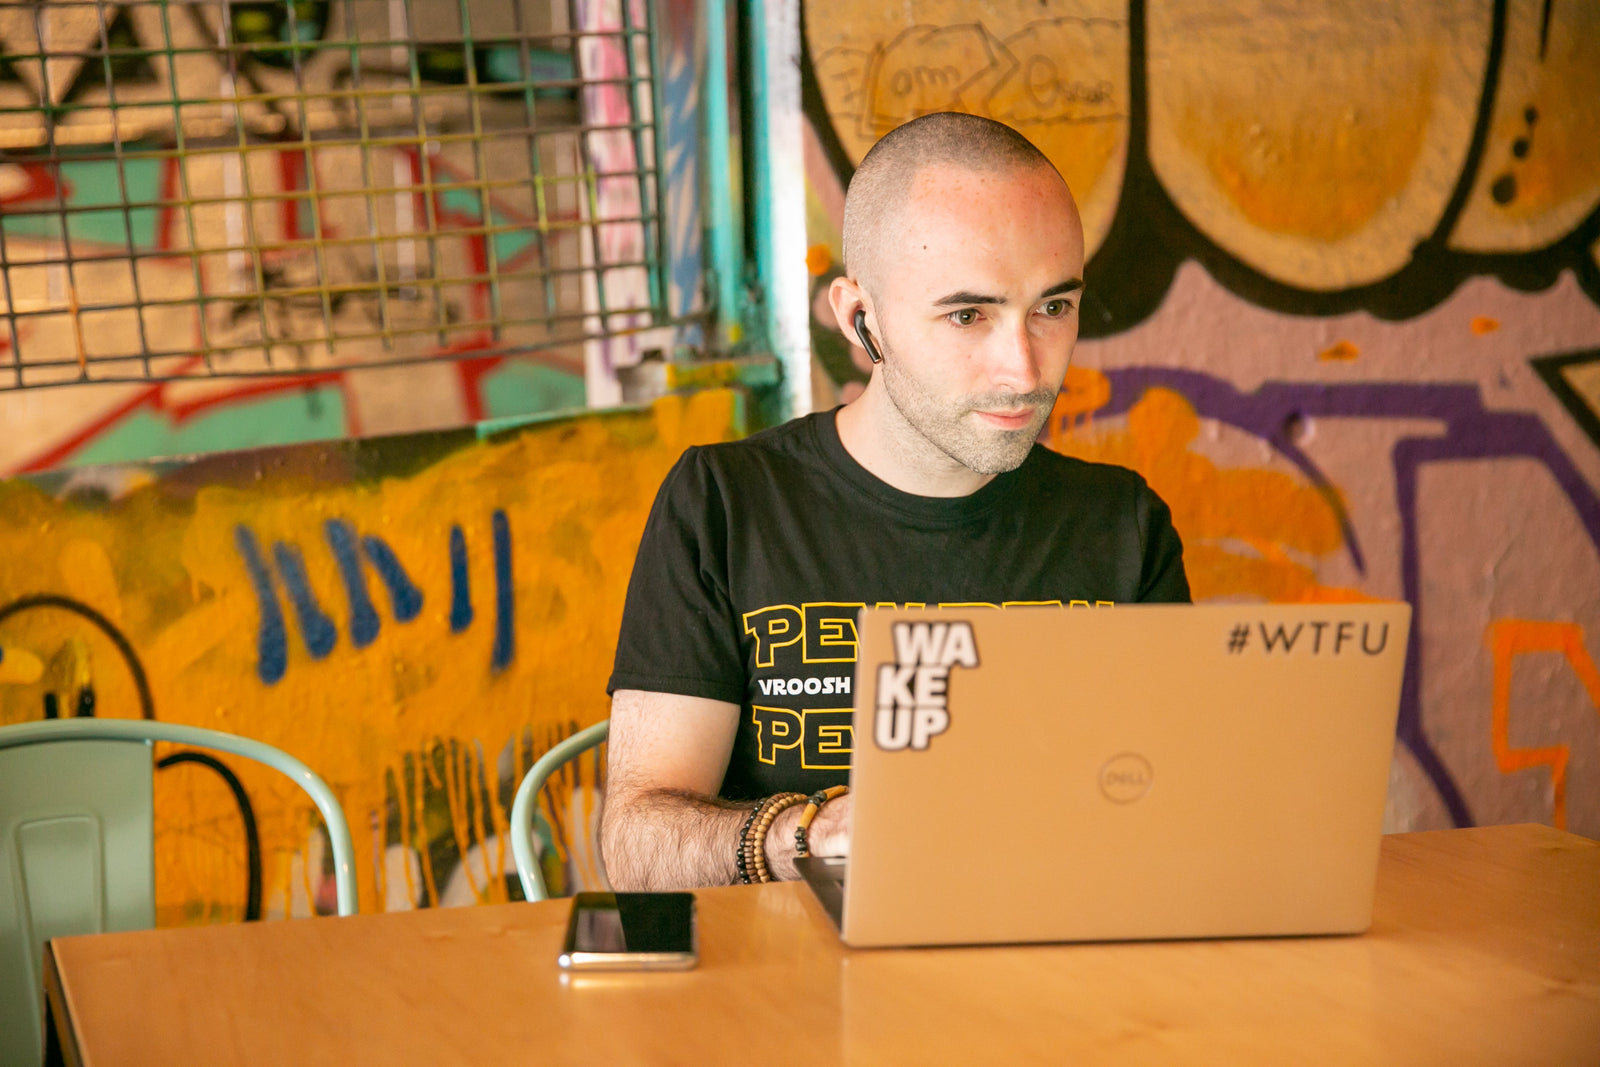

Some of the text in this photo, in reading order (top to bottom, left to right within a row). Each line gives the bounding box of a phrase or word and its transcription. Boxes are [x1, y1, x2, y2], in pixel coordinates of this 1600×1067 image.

[743, 602, 925, 668] PE
[894, 621, 978, 668] WA
[1227, 621, 1390, 656] #WTFU
[758, 676, 850, 696] VROOSH
[878, 664, 948, 707] KE
[752, 704, 856, 769] PE
[875, 706, 949, 750] UP
